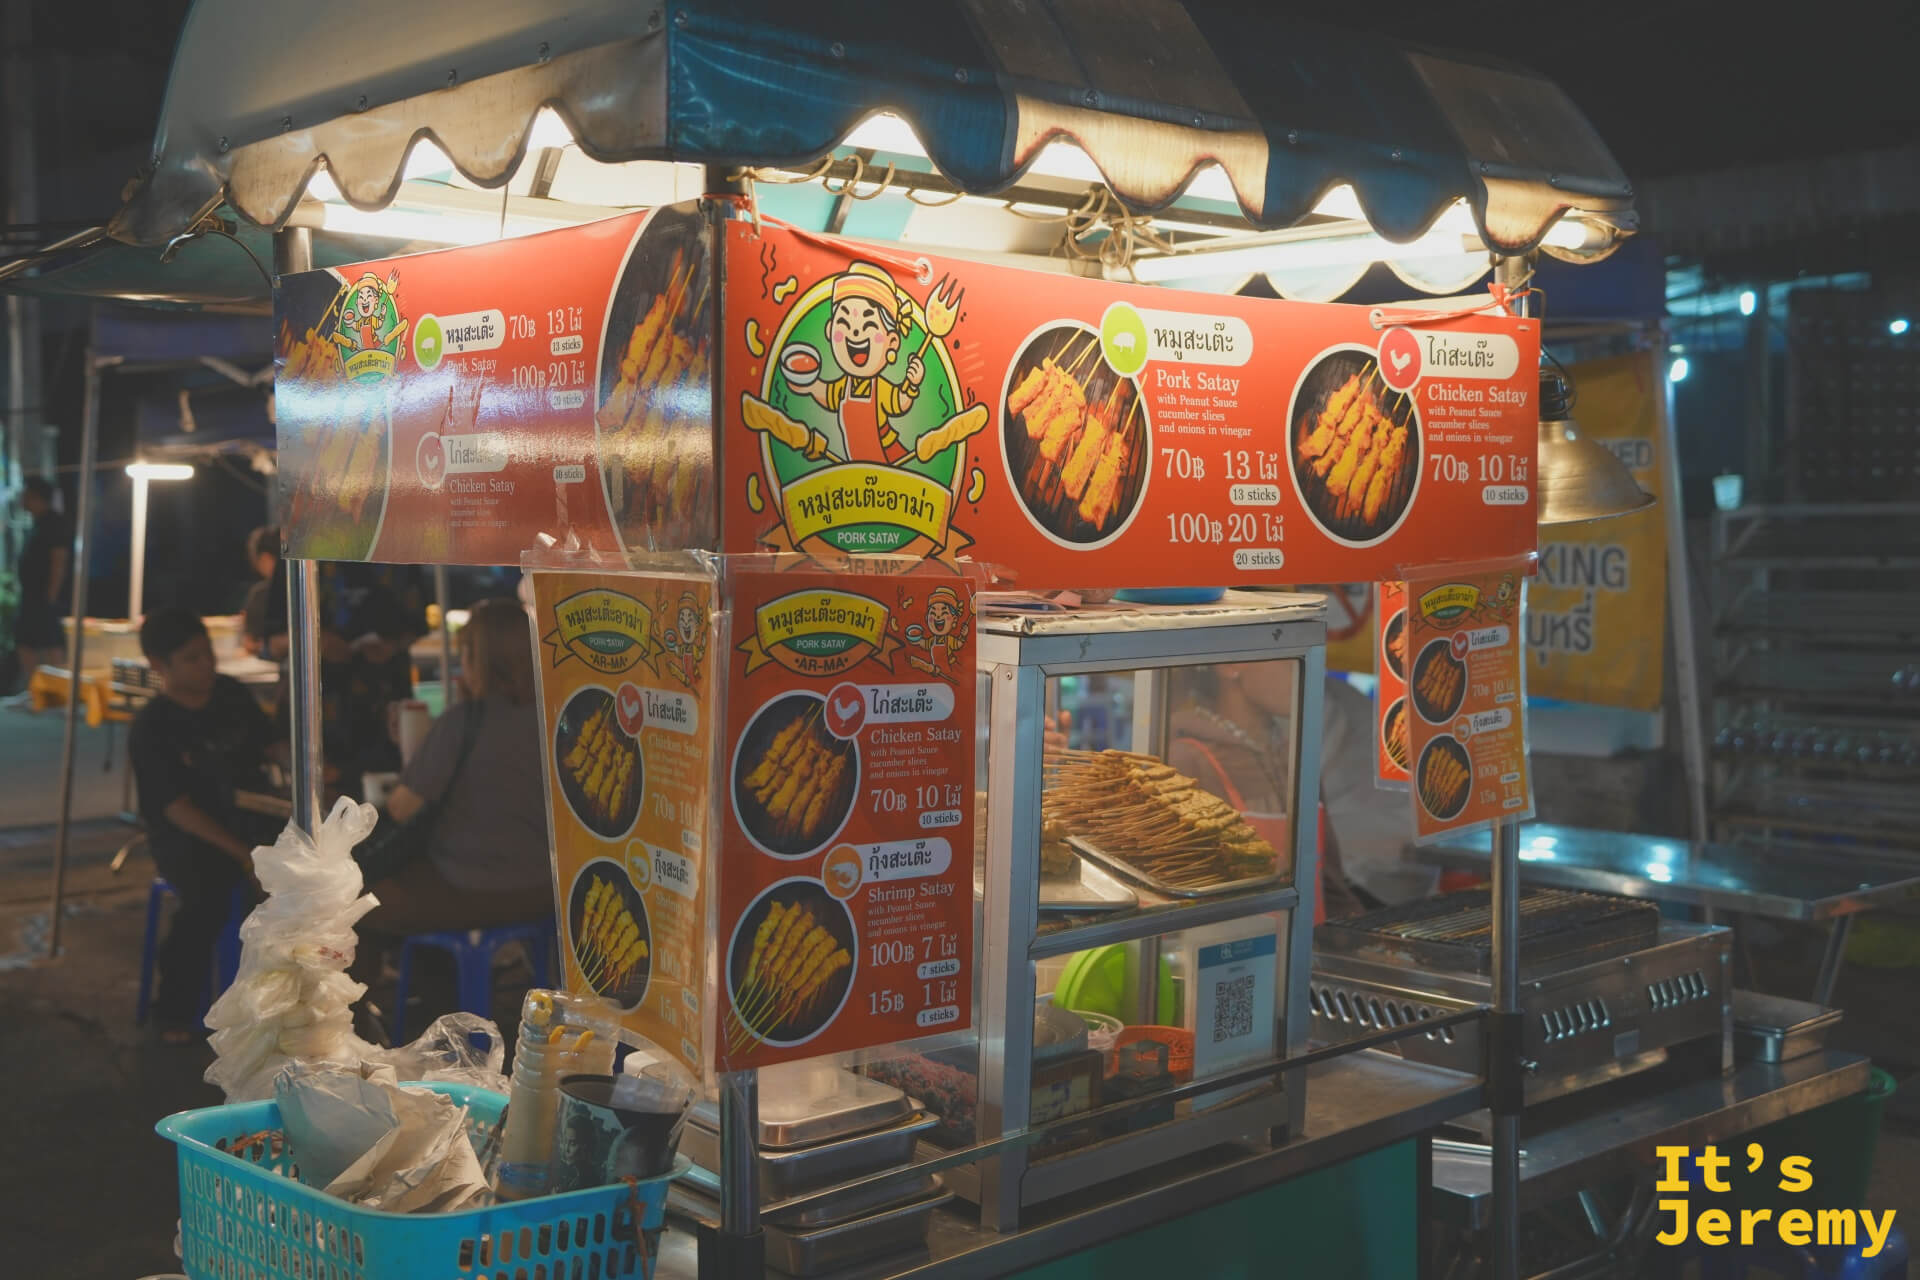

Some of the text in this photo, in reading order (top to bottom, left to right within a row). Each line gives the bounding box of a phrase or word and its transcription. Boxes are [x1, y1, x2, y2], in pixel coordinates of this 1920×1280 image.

[547, 308, 565, 334] 13
[568, 306, 582, 331] ไม้
[446, 315, 494, 351] หมูสะเต๊ะ
[1154, 322, 1234, 360] หมูสะเต๊ะ
[552, 338, 581, 352] 13 sticks
[1426, 336, 1494, 368] ไก่สะเต๊ะ
[471, 356, 496, 373] Satay
[549, 362, 568, 387] 20
[571, 360, 584, 385] ไม้
[1156, 368, 1240, 396] Pork Satay
[1157, 394, 1238, 408] with Peanut Sauce
[1428, 384, 1528, 408] Chicken Satay
[1158, 408, 1225, 422] cucumber slices
[1428, 406, 1446, 416] with
[1448, 406, 1476, 417] Peanut
[1159, 422, 1252, 438] and onions in vinegar
[1428, 419, 1490, 430] cucumber slices
[1428, 432, 1514, 444] and onions in vinegar
[1223, 450, 1250, 480] 13
[1256, 451, 1278, 480] ไม้
[1478, 454, 1504, 482] 10
[1509, 456, 1528, 481] ไม้
[450, 478, 516, 496] Chicken Satay
[1233, 487, 1276, 502] 13 sticks
[1485, 489, 1526, 500] 10 sticks
[1228, 512, 1257, 542] 20
[1262, 514, 1284, 542] ไม้
[838, 532, 900, 544] PORK SATAY
[1236, 552, 1280, 566] 20 sticks
[796, 639, 846, 649] PORK SATAY
[798, 658, 846, 672] AR-MA
[870, 688, 933, 715] ไก่สะเต๊ะ
[871, 727, 962, 744] Chicken Satay
[870, 770, 884, 779] and
[916, 784, 939, 808] 10
[944, 784, 962, 807] ไม้
[922, 812, 959, 825] 10 sticks
[869, 840, 932, 879] กุ้งสะเต๊ะ
[868, 882, 956, 903] Shrimp Satay
[922, 936, 934, 960] 7
[940, 933, 958, 956] ไม้
[922, 962, 955, 976] 7 sticks
[924, 984, 932, 1006] 1
[940, 980, 957, 1003] ไม้
[922, 1010, 954, 1023] 1 sticks
